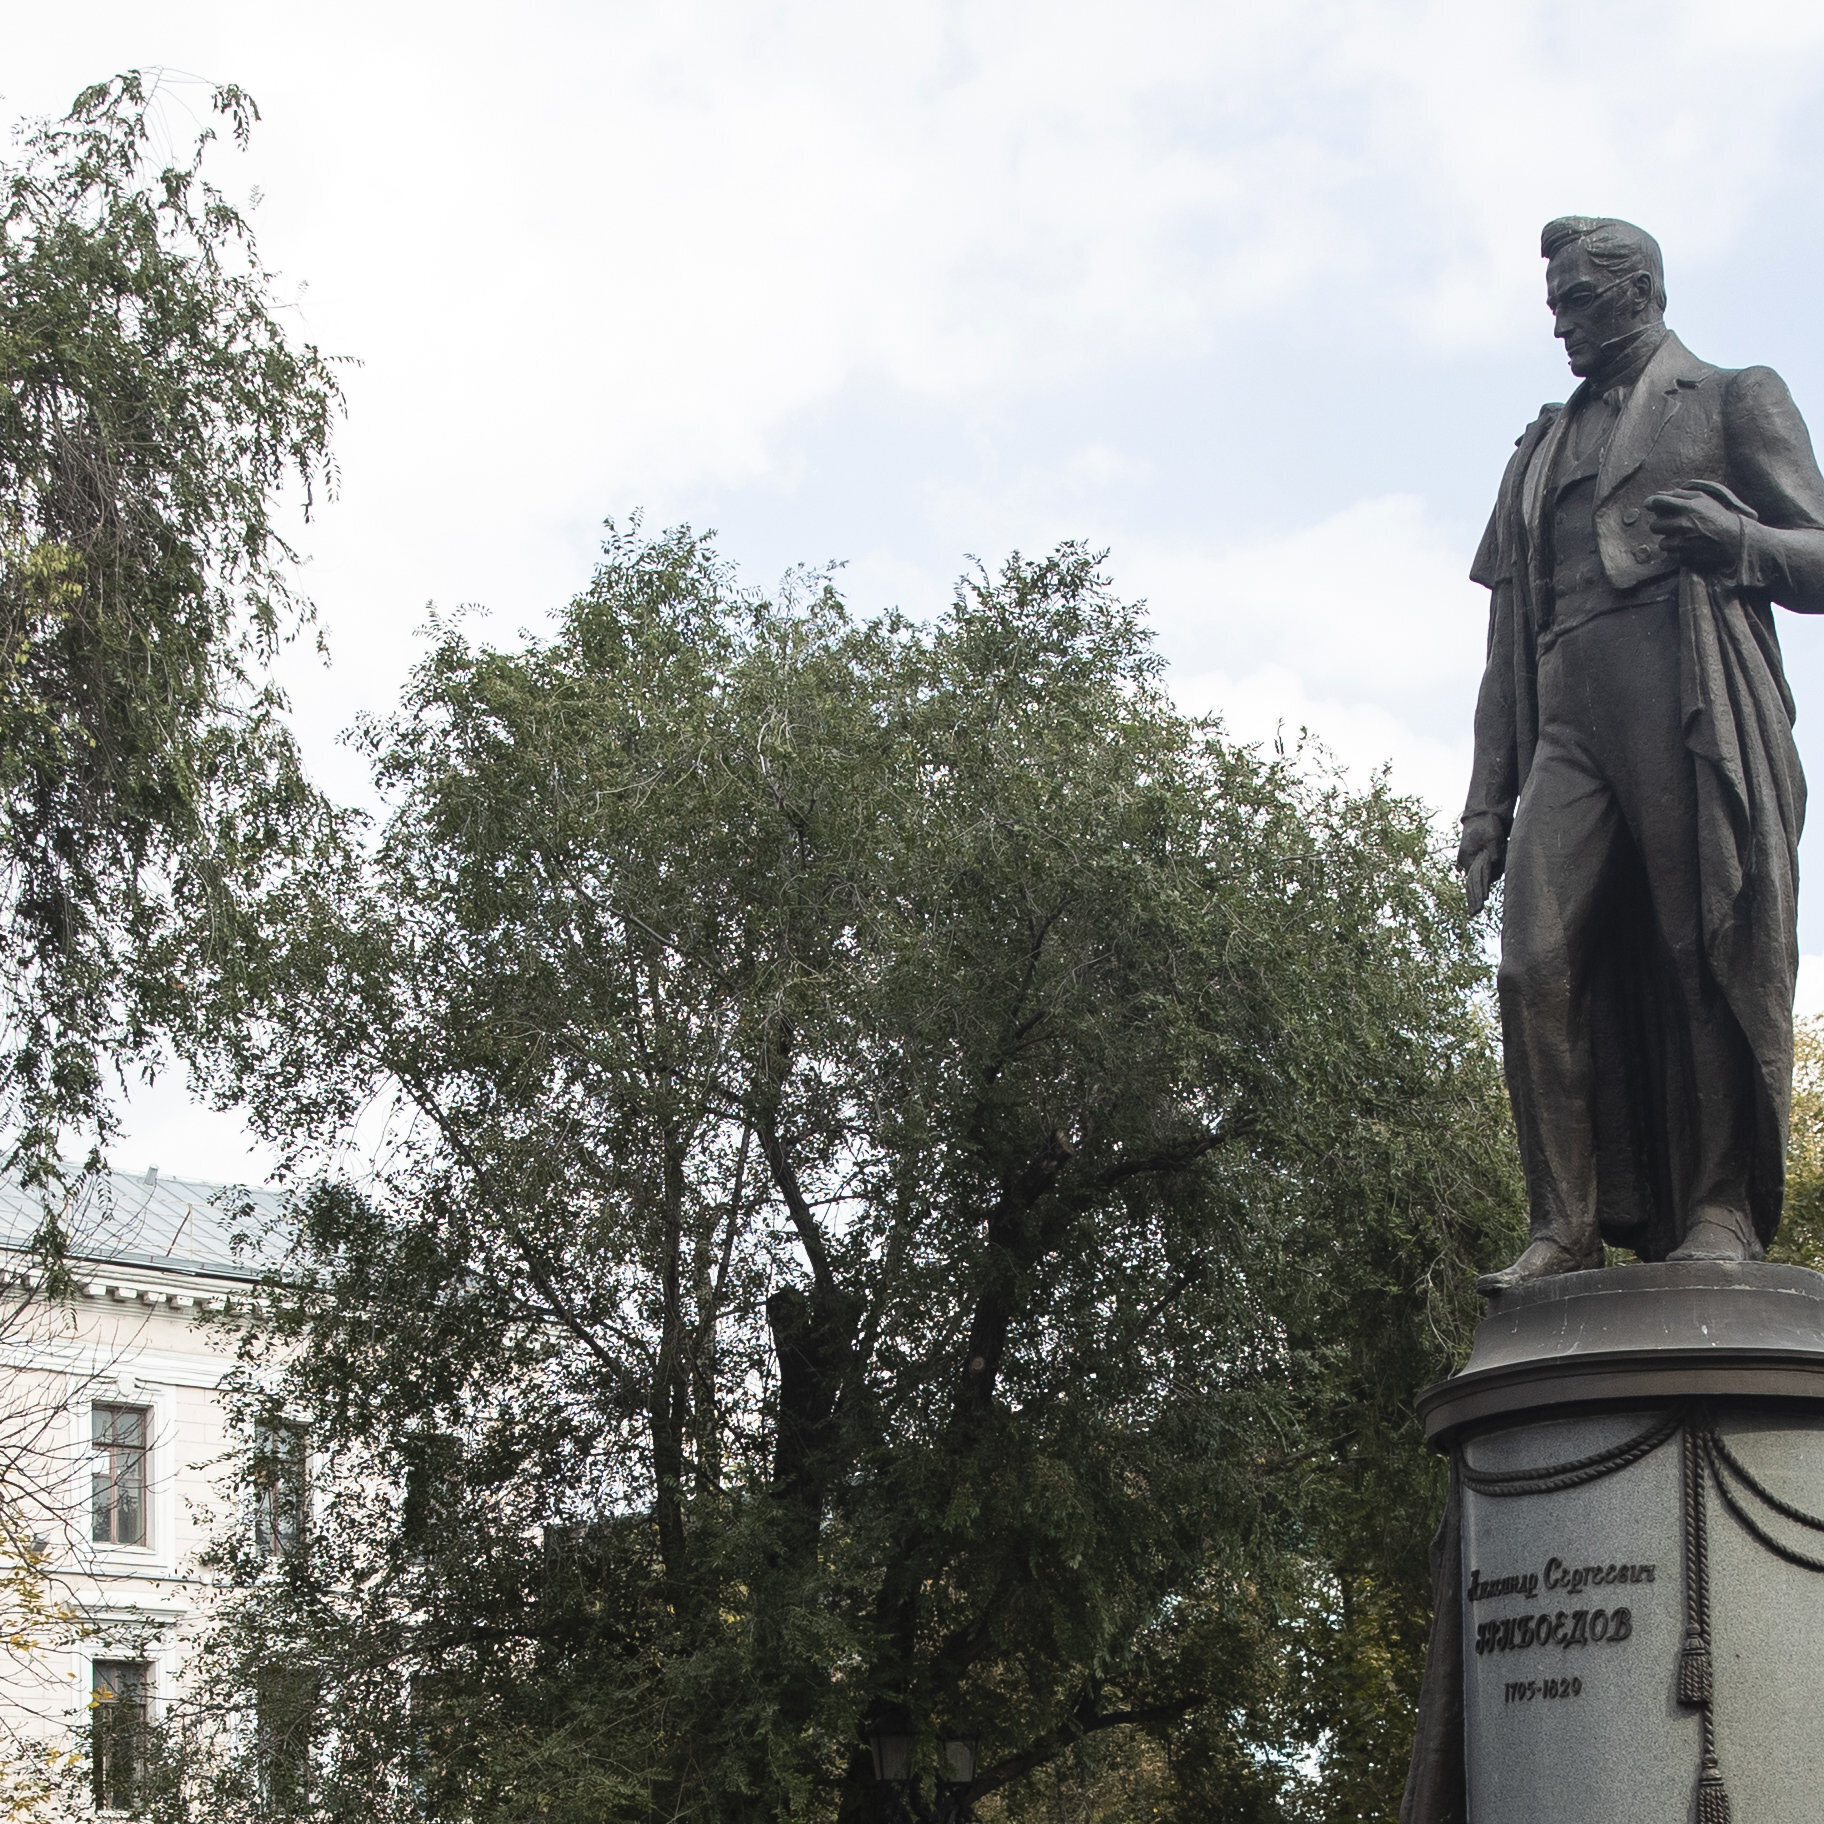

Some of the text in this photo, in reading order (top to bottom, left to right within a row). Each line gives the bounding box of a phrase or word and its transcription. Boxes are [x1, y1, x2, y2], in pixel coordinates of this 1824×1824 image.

[1543, 1557, 1656, 1594] Сергеевич
[1476, 1607, 1632, 1655] ГРИБОЕДОВ
[1504, 1677, 1583, 1702] 1795-1829
